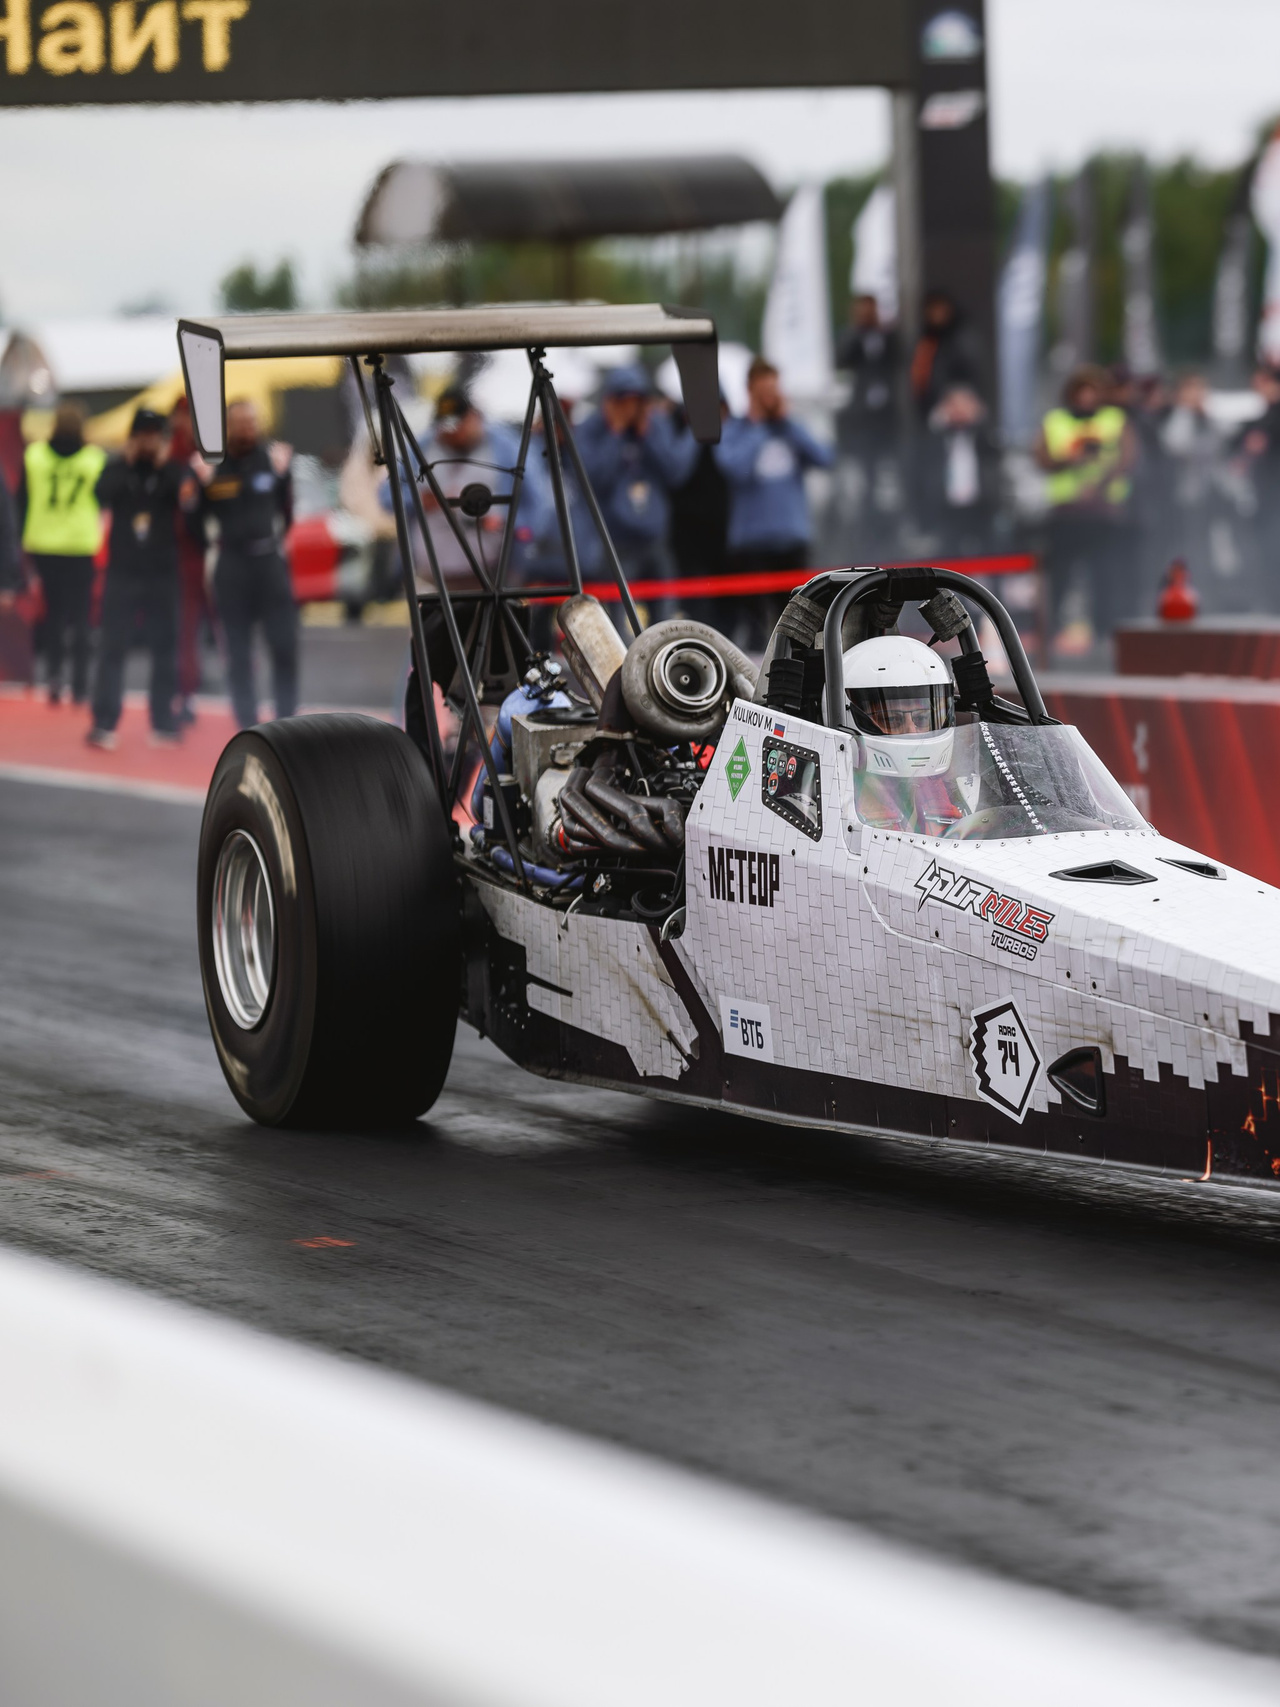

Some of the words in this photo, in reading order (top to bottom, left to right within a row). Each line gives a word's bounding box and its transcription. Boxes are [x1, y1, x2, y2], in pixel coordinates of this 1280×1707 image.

[733, 706, 763, 728] KULIKOV
[763, 716, 773, 732] M.
[708, 846, 780, 908] МЕТЕОР
[991, 930, 1037, 961] TURBOS
[740, 1017, 764, 1049] ВТБ
[998, 1025, 1016, 1037] RDRC
[998, 1039, 1020, 1077] 74
